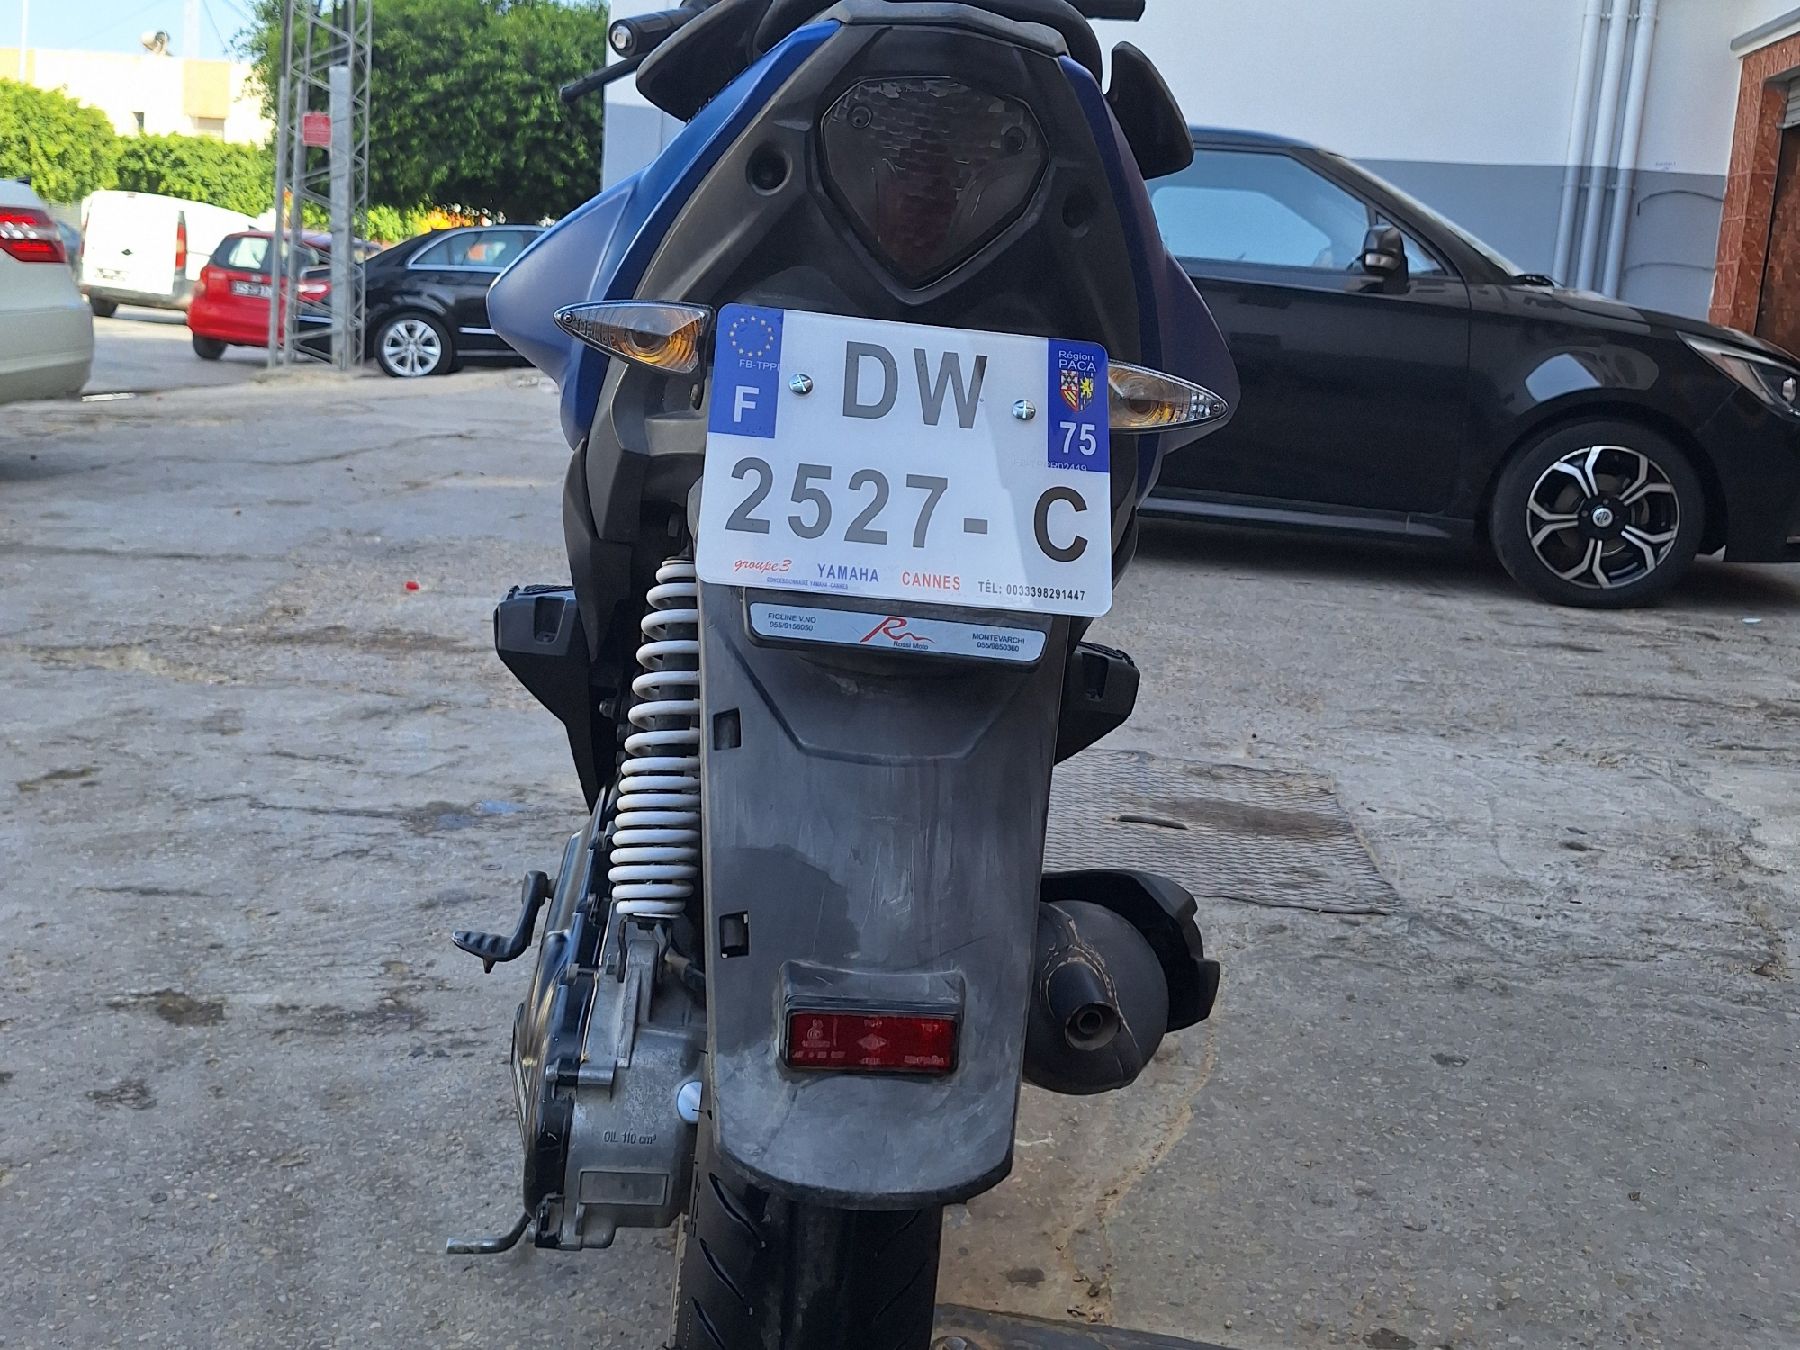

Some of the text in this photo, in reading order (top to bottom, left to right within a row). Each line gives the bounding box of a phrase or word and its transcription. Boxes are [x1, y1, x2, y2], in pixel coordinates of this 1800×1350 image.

[1058, 350, 1094, 361] Région
[1058, 359, 1096, 372] PACA
[842, 341, 988, 429] DW
[733, 385, 760, 423] F
[1060, 421, 1097, 456] 75
[817, 563, 879, 582] YAMAHA
[902, 571, 960, 590] CANNES
